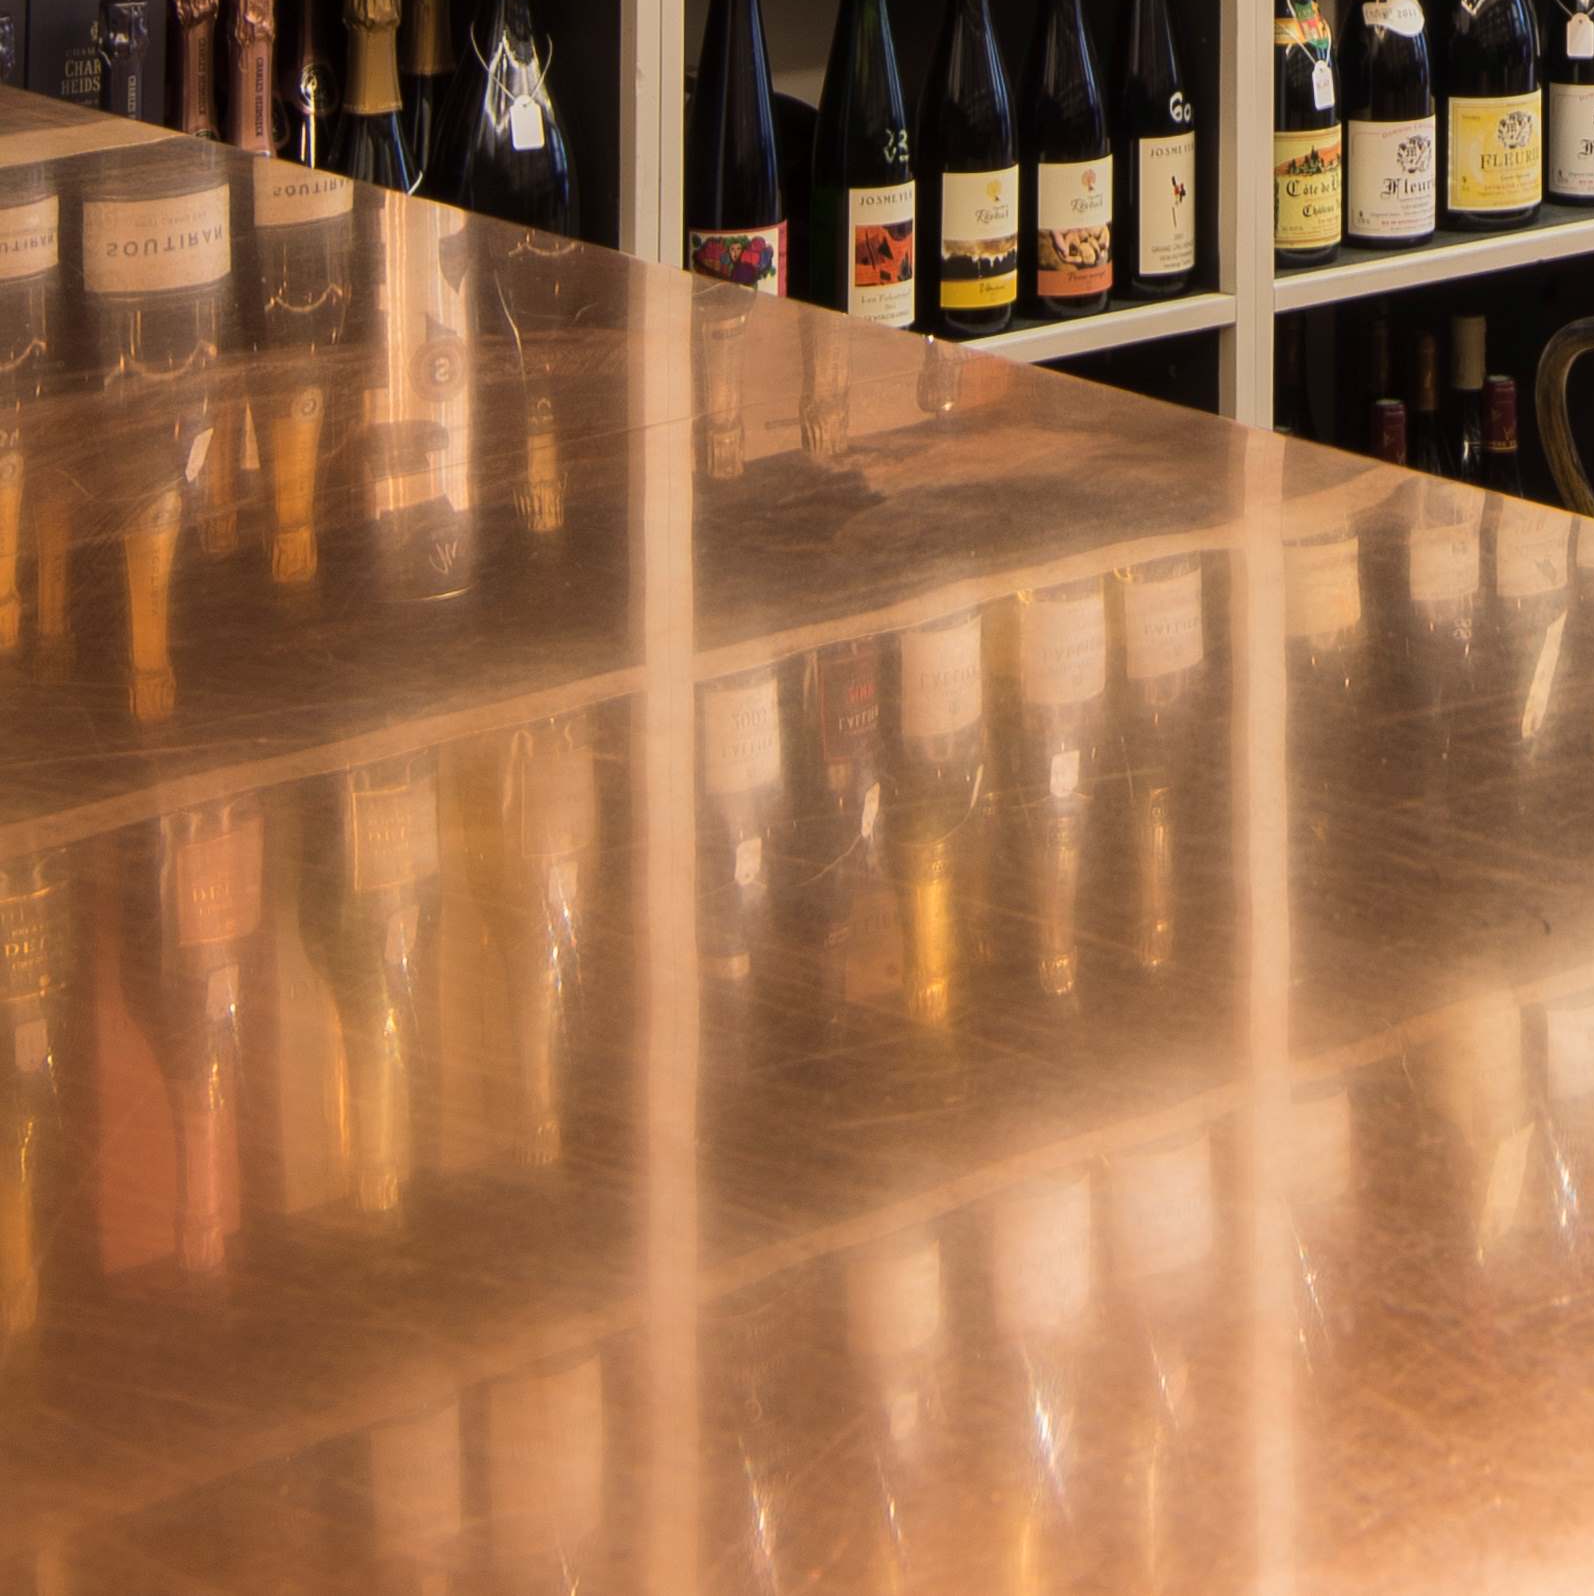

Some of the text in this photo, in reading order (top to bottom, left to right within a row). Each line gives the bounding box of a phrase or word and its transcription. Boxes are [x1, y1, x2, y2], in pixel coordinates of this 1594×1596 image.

[64, 58, 101, 77] CHAR
[61, 76, 101, 95] HEIDS
[254, 56, 265, 137] CHARLES HEIDSIECK
[1286, 178, 1331, 199] Côte de
